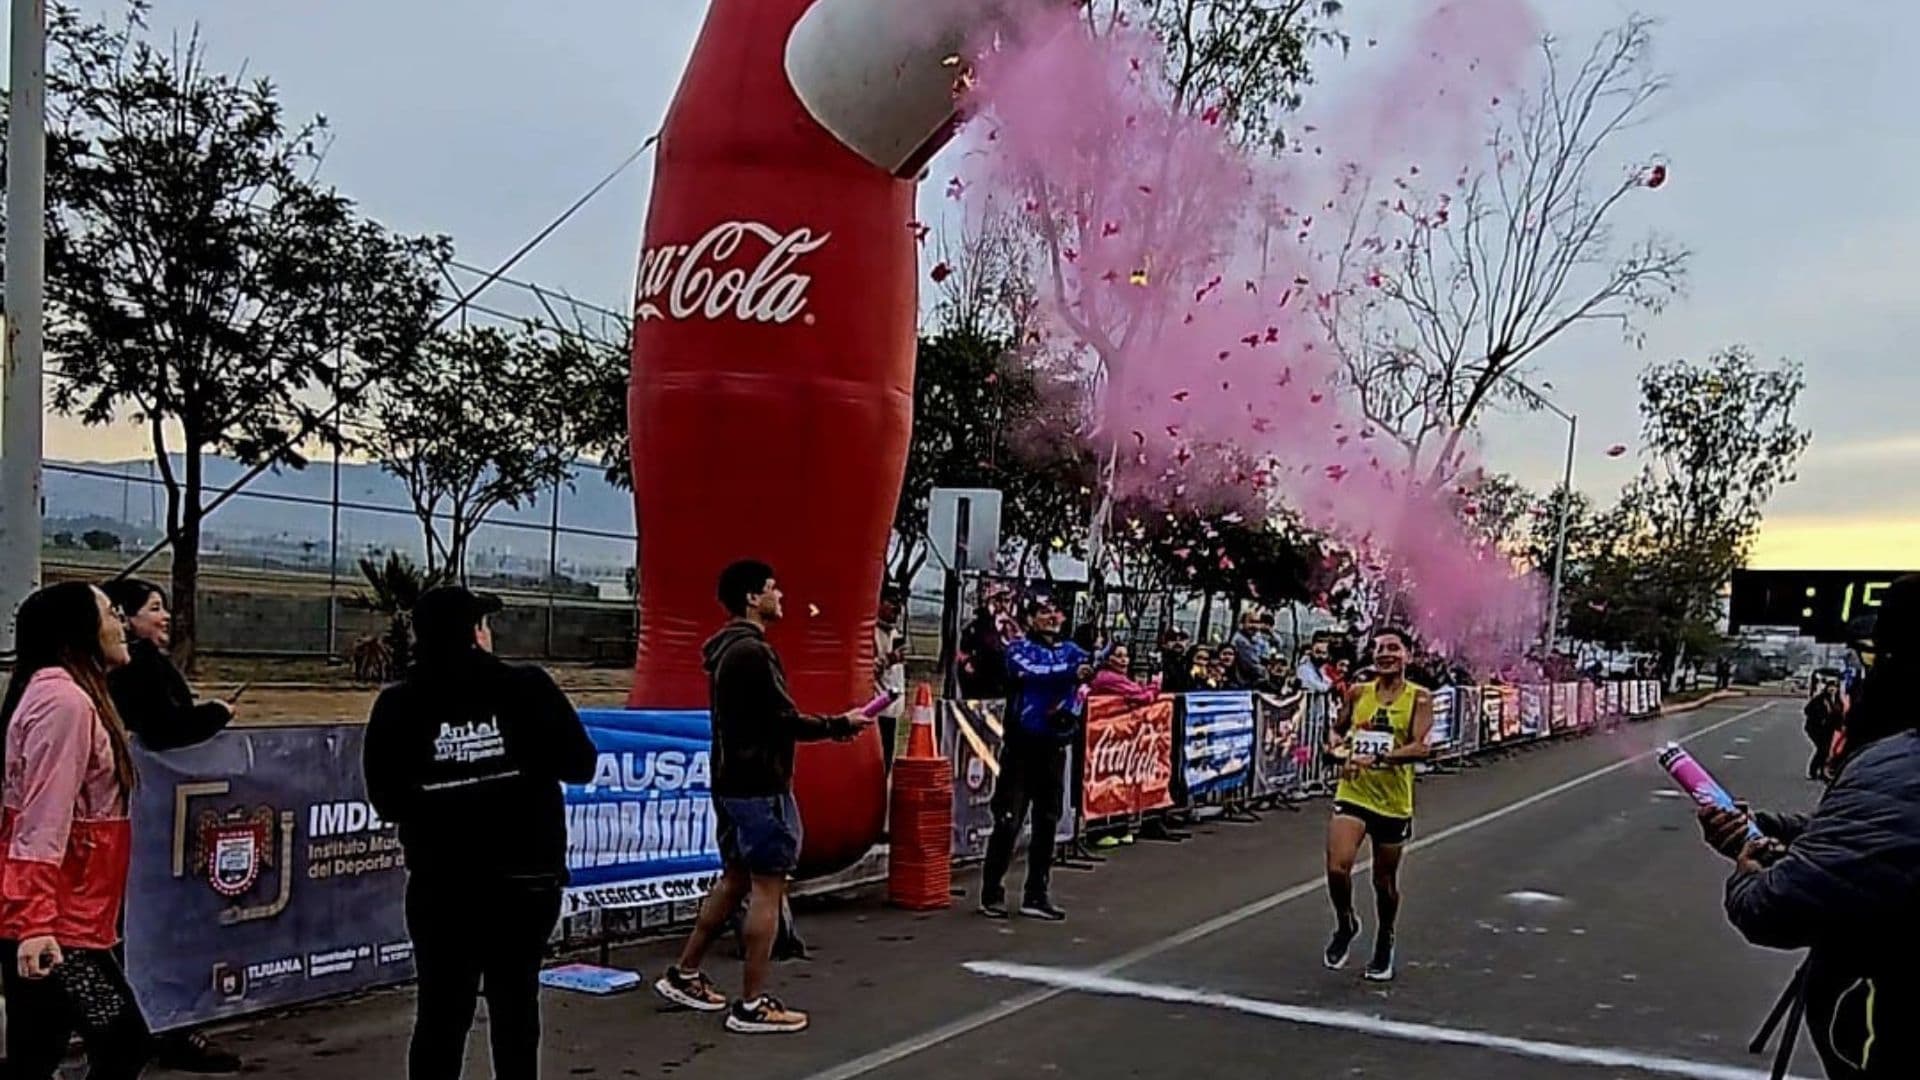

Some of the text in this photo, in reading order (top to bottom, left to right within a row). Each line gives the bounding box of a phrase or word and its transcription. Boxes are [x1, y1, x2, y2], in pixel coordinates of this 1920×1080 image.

[308, 838, 367, 860] Instituto
[308, 859, 331, 879] del
[334, 853, 393, 877] Deporte
[583, 883, 662, 908] REGRESA
[248, 958, 302, 979] TIJUANA
